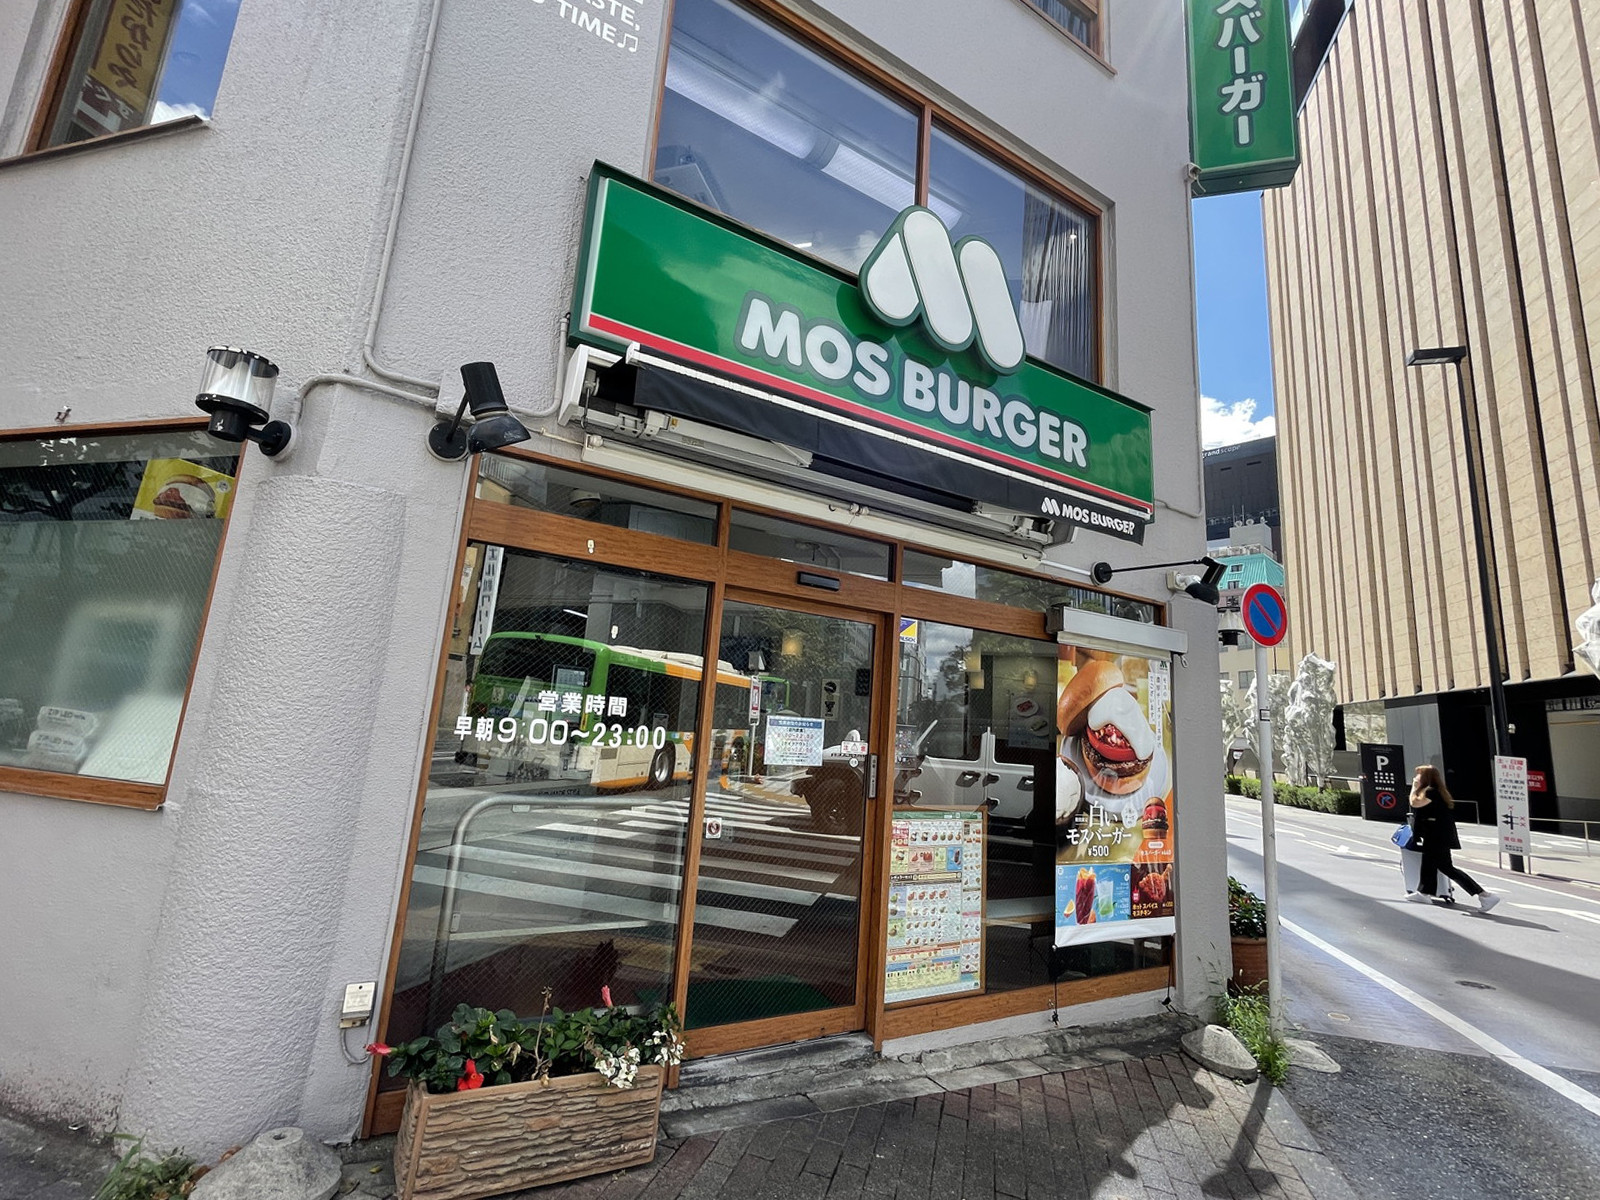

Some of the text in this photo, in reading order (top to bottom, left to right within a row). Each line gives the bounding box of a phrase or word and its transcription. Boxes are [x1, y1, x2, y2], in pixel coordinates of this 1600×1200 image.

[556, 0, 617, 44] TIME
[585, 0, 640, 31] STE,
[741, 298, 1087, 468] MOS BURGER
[1061, 503, 1135, 536] MOS BURGER
[538, 690, 628, 717] 営業時間
[1376, 755, 1389, 771] P
[1089, 801, 1118, 828] 白い
[1066, 827, 1132, 846] モスバーガー
[1087, 845, 1110, 857] ¥500
